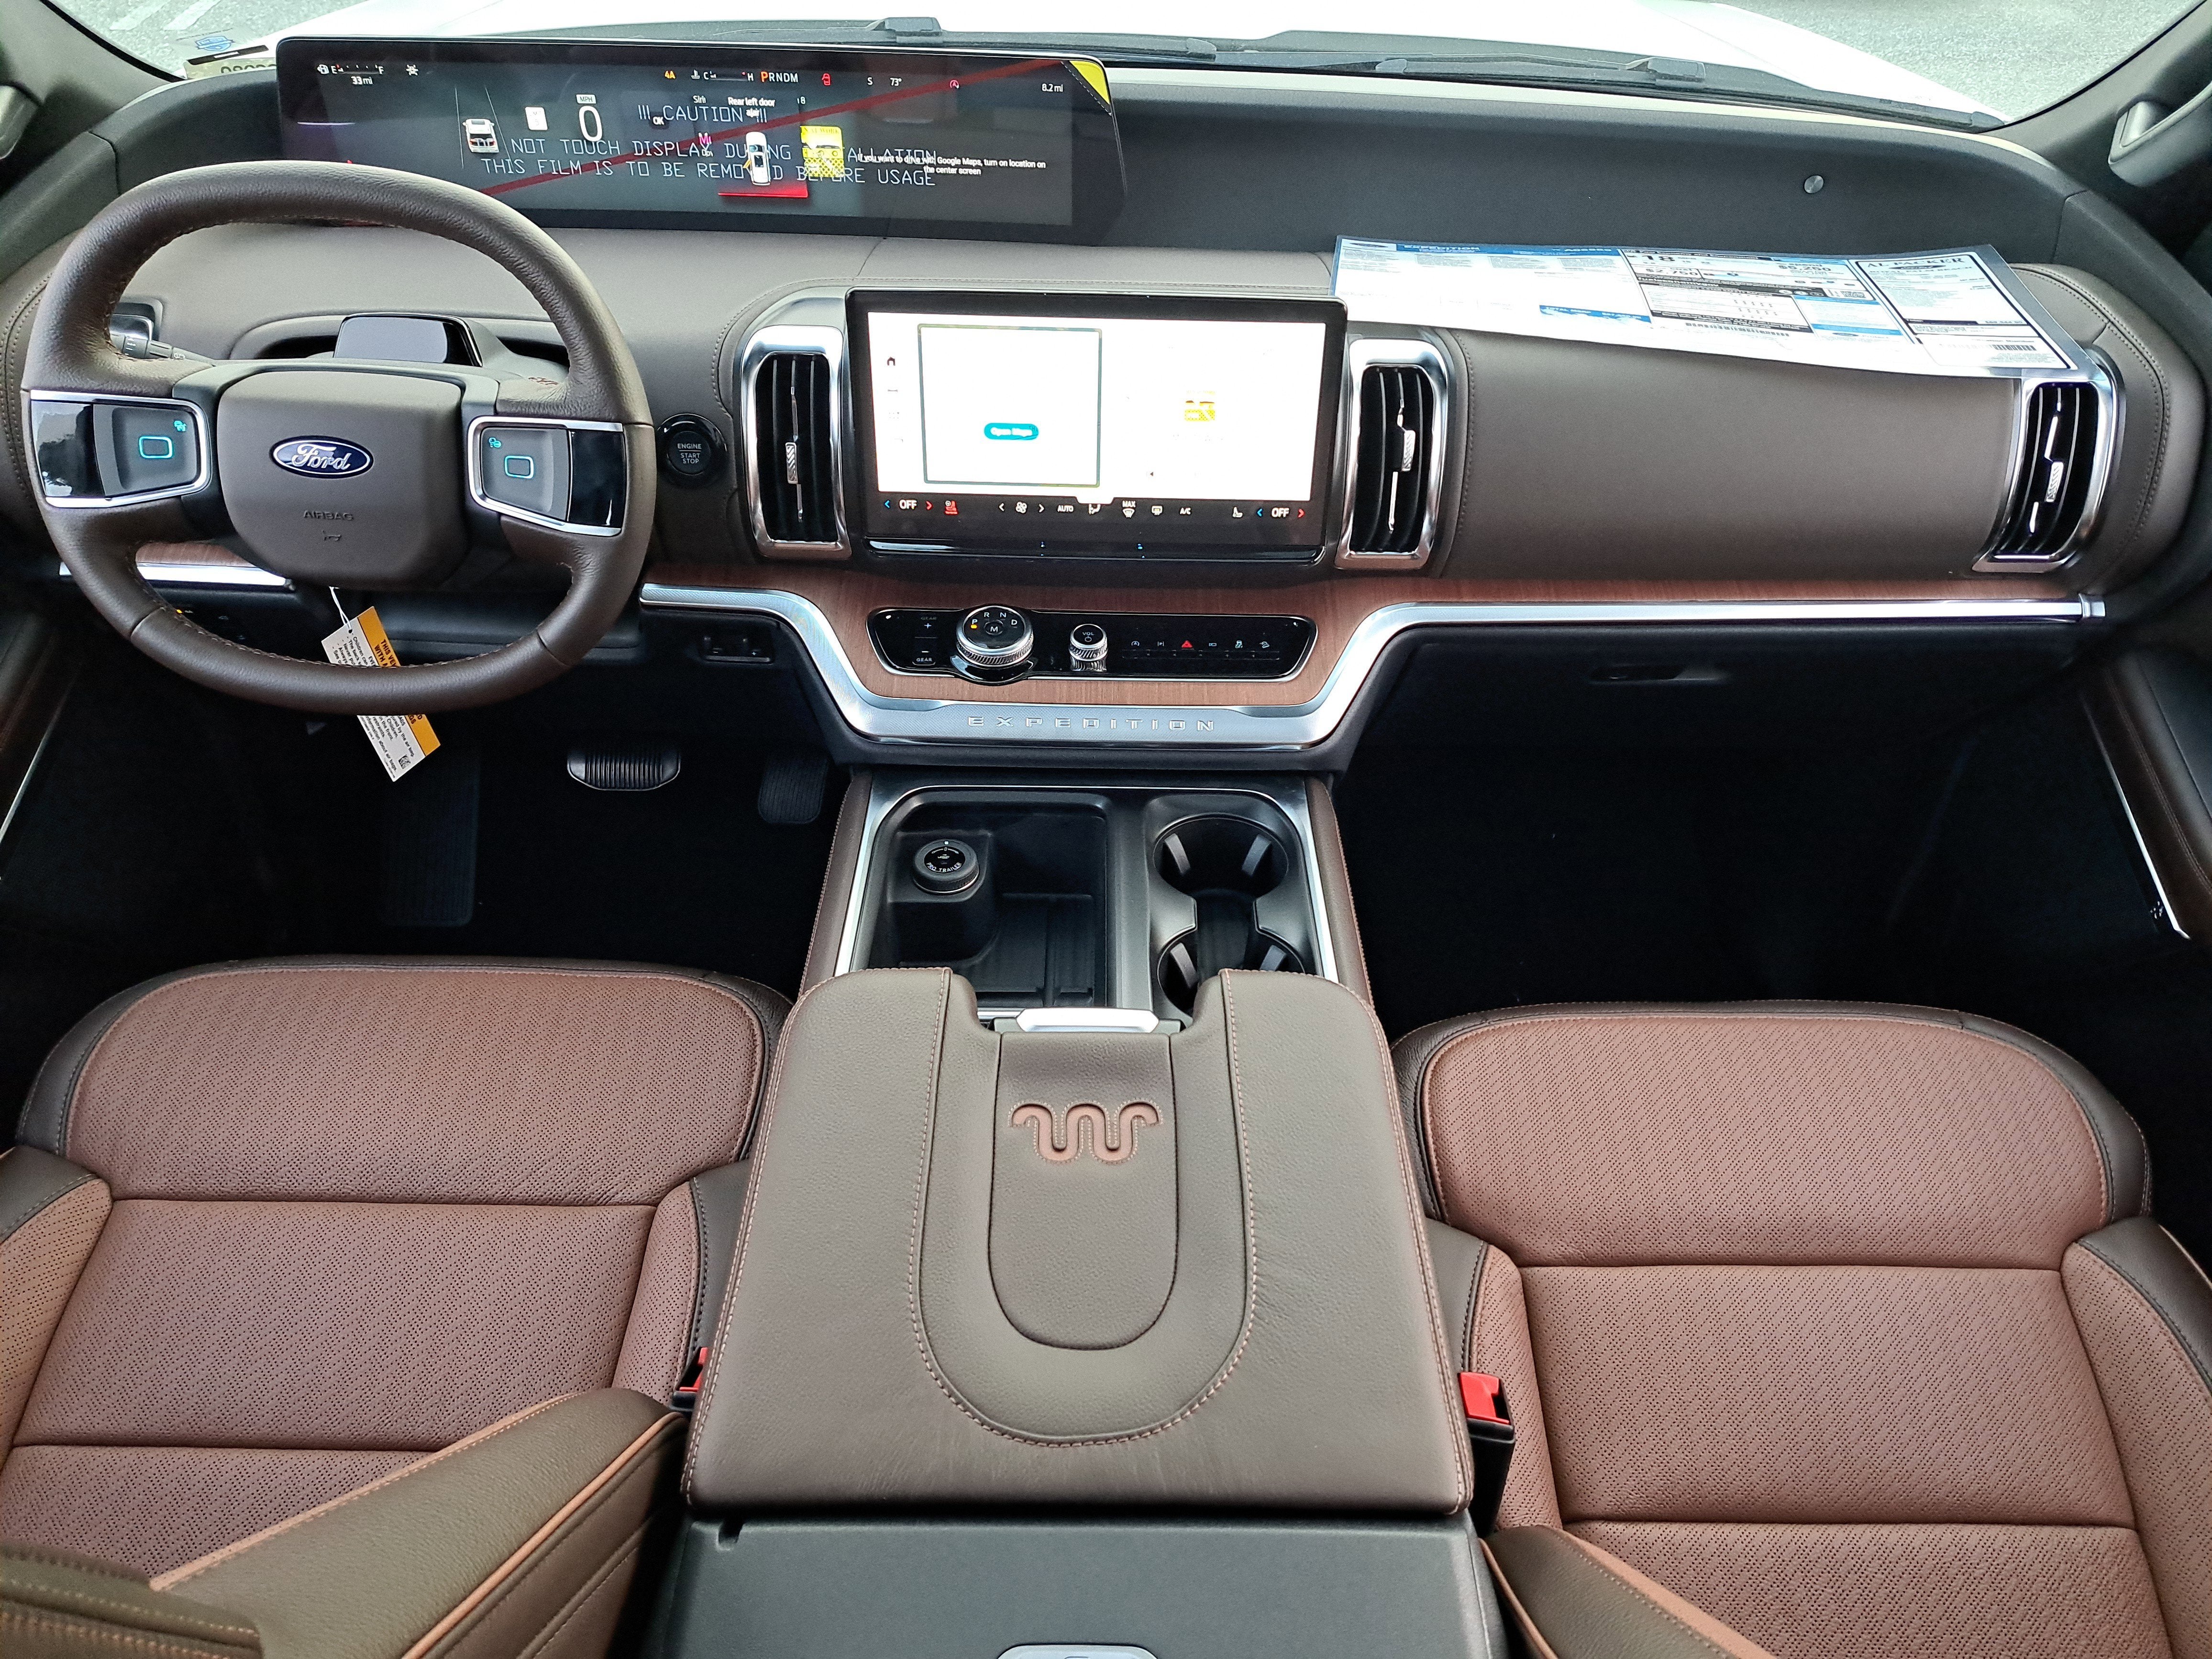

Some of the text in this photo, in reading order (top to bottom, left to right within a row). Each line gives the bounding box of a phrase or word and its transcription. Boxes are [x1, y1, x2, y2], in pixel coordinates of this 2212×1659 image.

[728, 97, 775, 107] Rear left door
[663, 105, 743, 122] CAUTION
[579, 105, 603, 142] 0
[653, 117, 664, 125] OK
[511, 138, 545, 154] NOT
[559, 139, 620, 155] TOUCH
[724, 143, 792, 160] DUNG
[937, 156, 961, 166] Google
[962, 157, 983, 167] Maps,
[1009, 159, 1036, 168] location
[481, 158, 526, 174] THIS
[537, 160, 582, 175] FILM
[594, 161, 614, 176] IS
[626, 161, 650, 177] TO
[661, 162, 686, 177] BE
[697, 163, 784, 180] REMOD
[877, 169, 936, 186] USAGE
[291, 443, 353, 470] Ford
[899, 499, 917, 509] OFF
[1180, 507, 1191, 515] A/C
[303, 510, 354, 520] AIRBAG
[1272, 507, 1289, 518] OFF
[343, 643, 352, 657] Never
[353, 636, 364, 657] Children
[374, 644, 386, 663] WITH
[380, 639, 391, 655] THIS
[339, 647, 348, 664] Always
[967, 716, 1215, 731] EXPEDITION
[378, 740, 388, 753] about
[926, 862, 962, 873] PRO TRAILER
